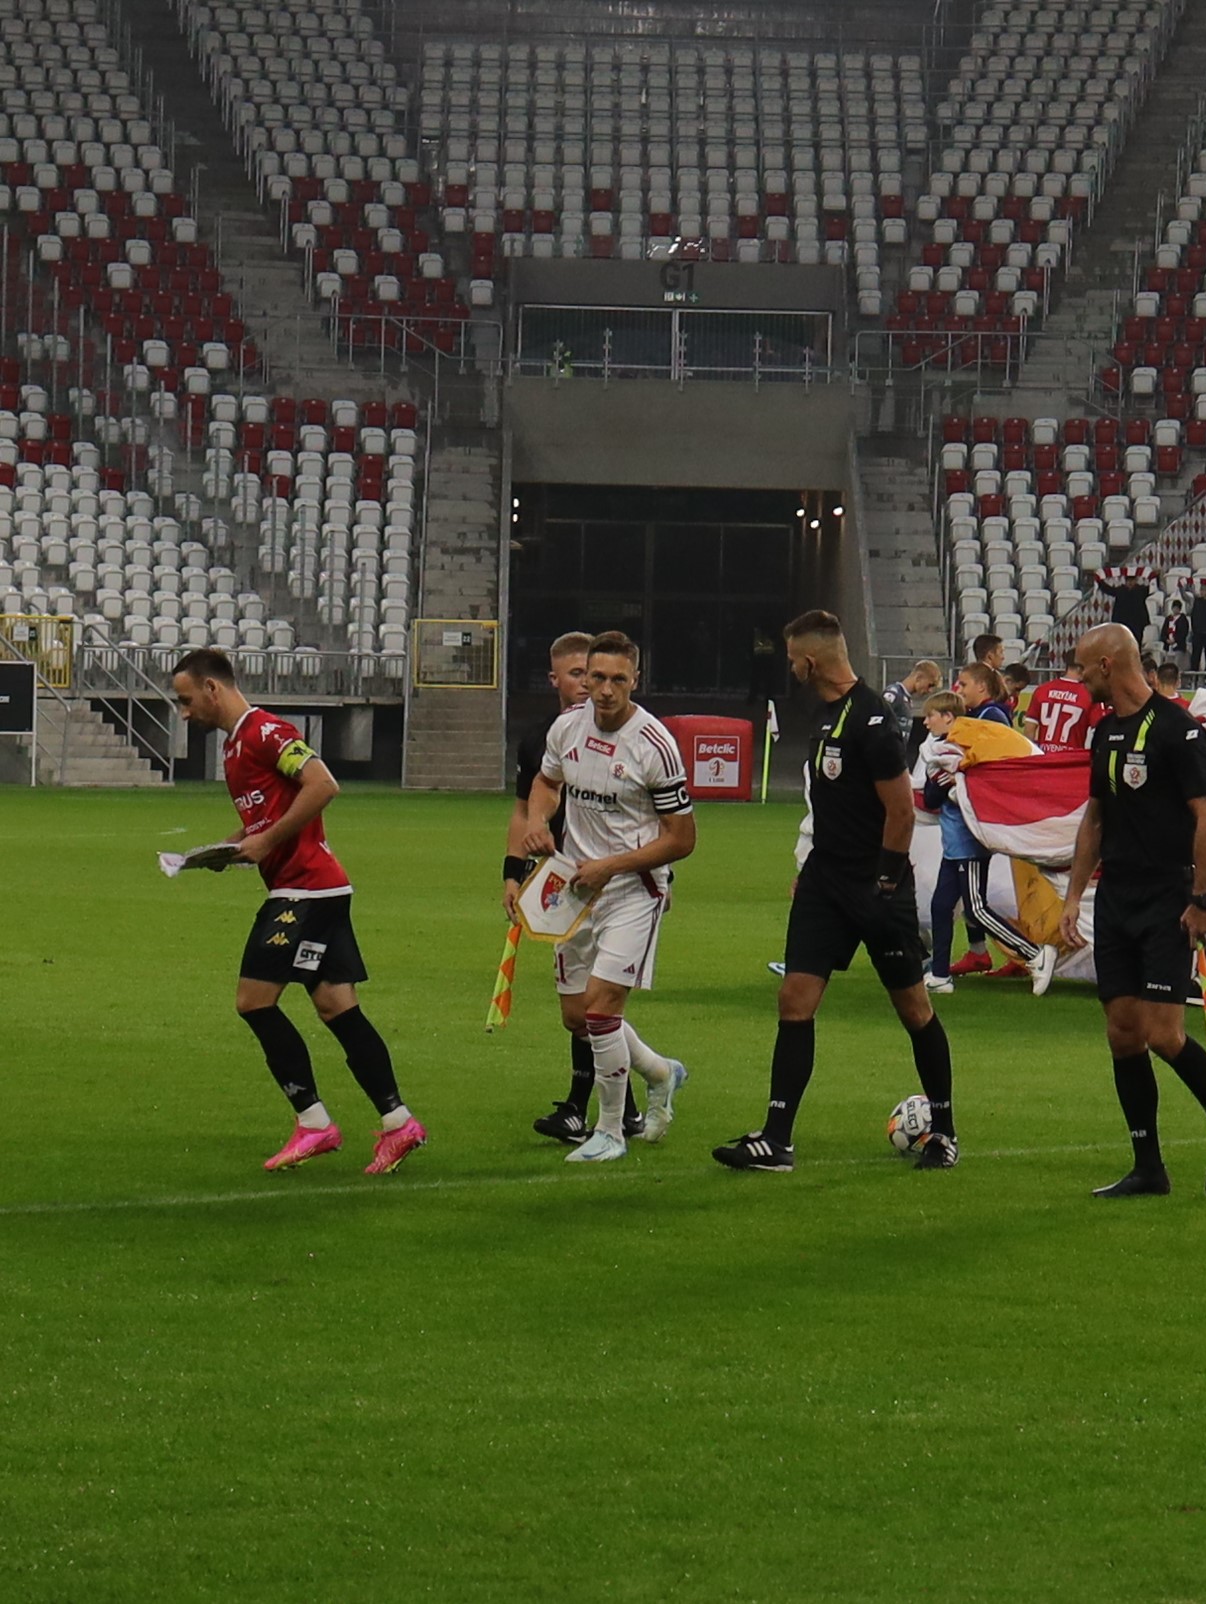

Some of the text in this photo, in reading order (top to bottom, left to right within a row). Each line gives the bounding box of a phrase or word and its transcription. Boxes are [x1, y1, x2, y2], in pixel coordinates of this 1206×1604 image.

[660, 262, 695, 292] G1
[1040, 702, 1083, 743] 47
[698, 743, 736, 754] Betclic
[907, 1100, 919, 1130] SELECT
